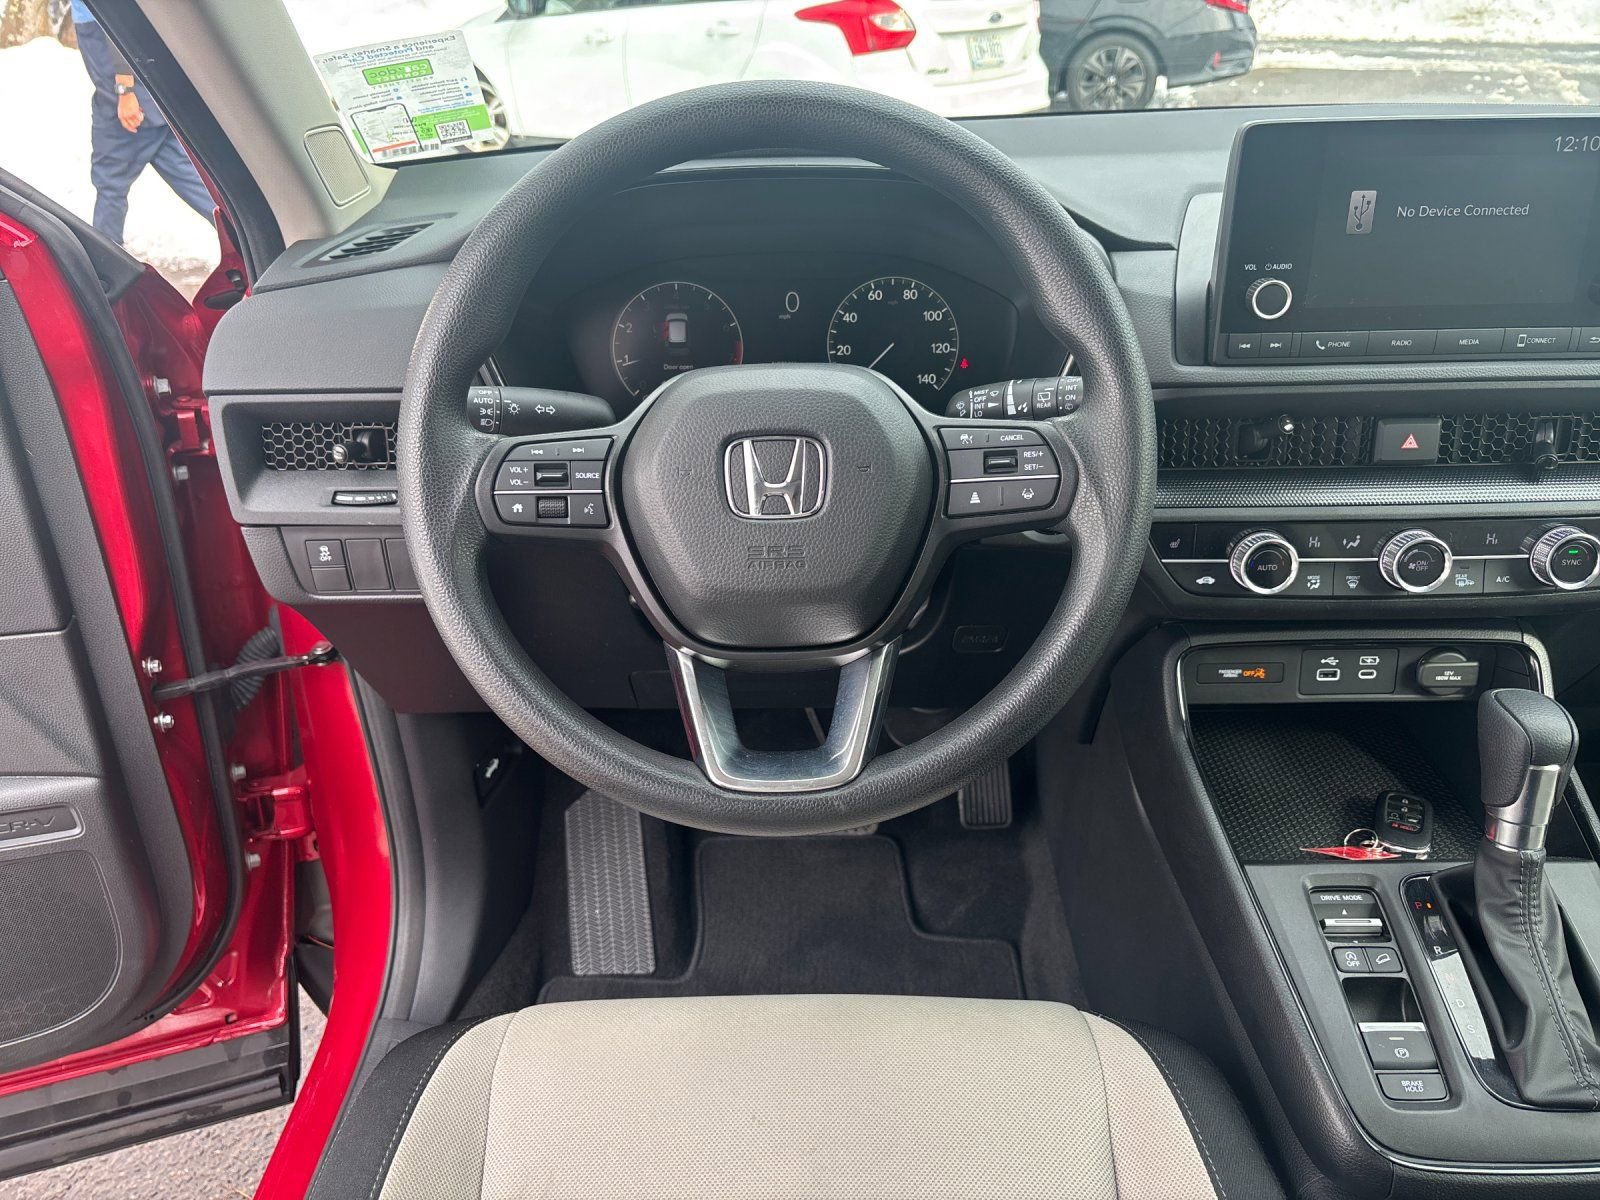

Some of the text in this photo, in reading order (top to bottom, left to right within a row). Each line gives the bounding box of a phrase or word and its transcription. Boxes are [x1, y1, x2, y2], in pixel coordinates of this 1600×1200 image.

[1554, 135, 1600, 152] 12:10
[1397, 203, 1530, 218] No Device Connected
[1244, 263, 1257, 271] VOL
[1272, 262, 1293, 271] AUDIO
[867, 289, 883, 301] 60
[903, 289, 918, 300] 80
[785, 291, 800, 313] 0
[842, 312, 858, 324] 40
[923, 310, 943, 322] 100
[625, 322, 633, 334] 2
[1327, 340, 1351, 349] PHONE
[1391, 338, 1413, 347] RADIO
[1458, 338, 1480, 346] MEDIA
[1526, 336, 1557, 345] CONNECT
[836, 344, 852, 356] 20
[930, 342, 951, 354] 120
[663, 363, 678, 371] Door
[917, 373, 937, 385] 140
[473, 397, 494, 405] AUTO
[973, 395, 987, 403] OFF
[973, 410, 983, 418] LO
[1000, 433, 1025, 442] CANCEL
[1414, 901, 1423, 909] P
[1433, 945, 1443, 955] R
[1456, 1000, 1466, 1008] D
[1466, 1024, 1476, 1034] S
